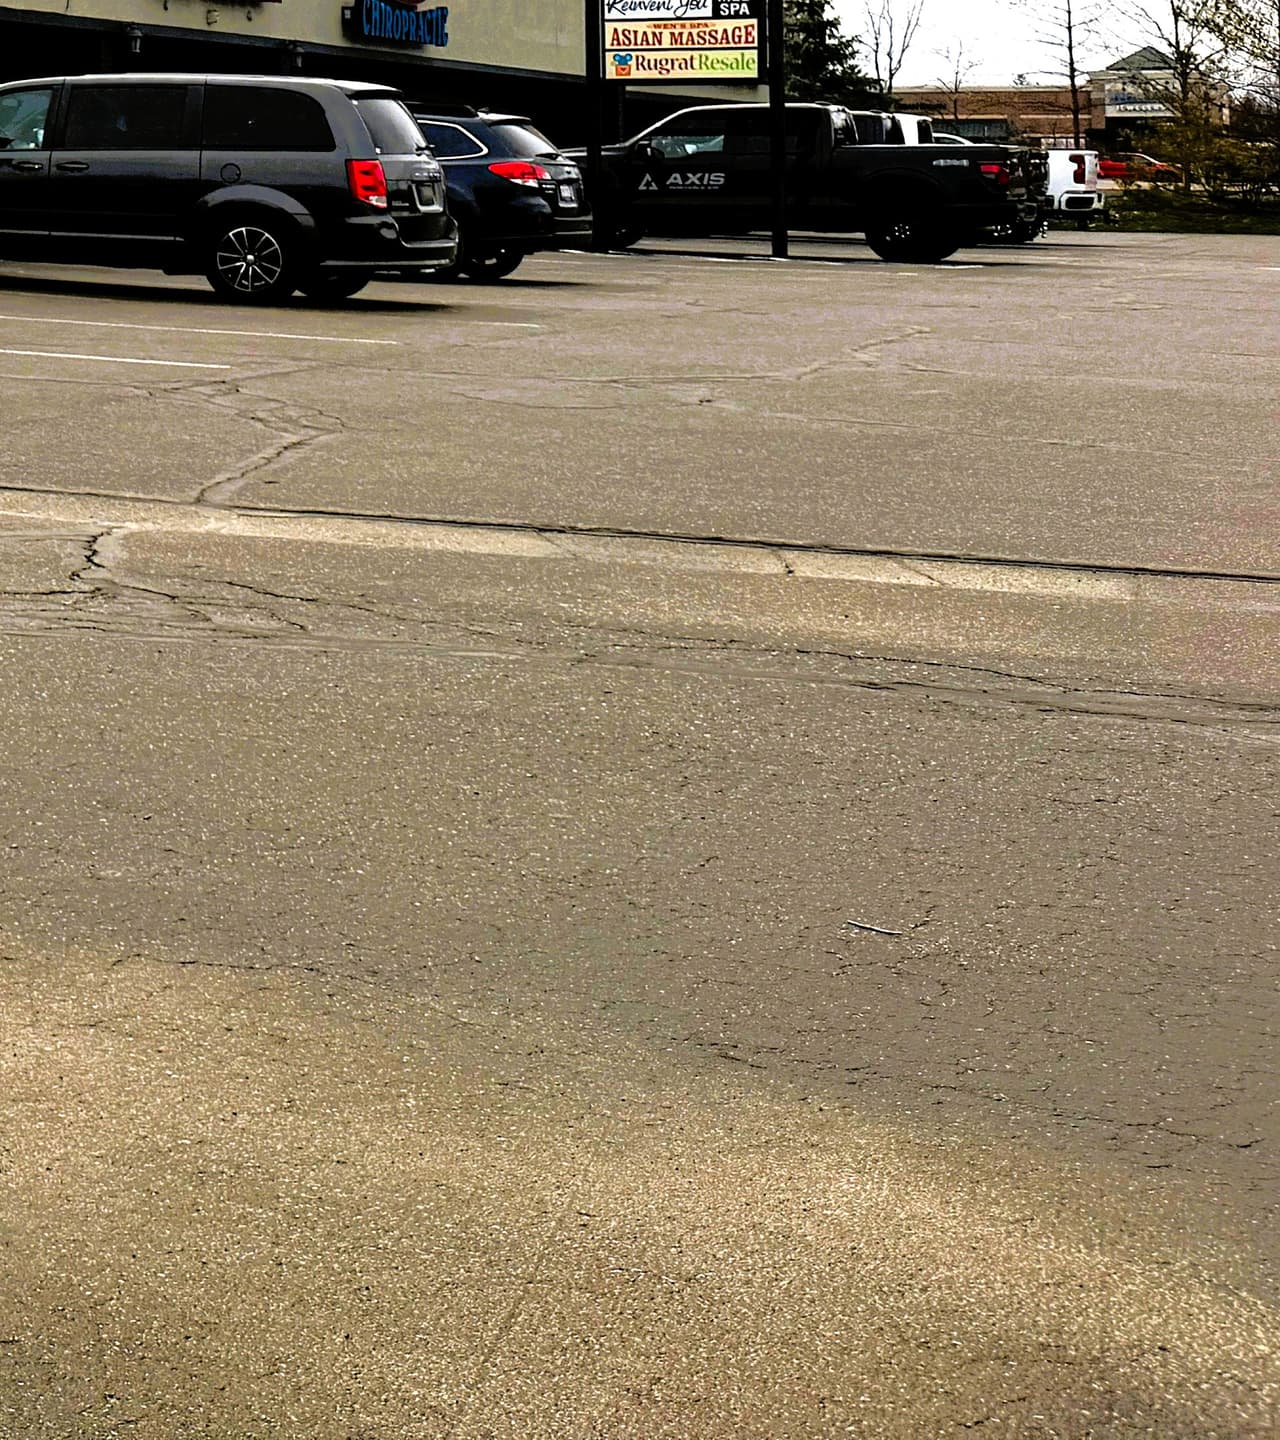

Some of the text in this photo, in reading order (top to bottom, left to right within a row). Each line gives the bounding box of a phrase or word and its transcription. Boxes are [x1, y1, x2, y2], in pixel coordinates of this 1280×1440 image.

[720, 3, 750, 16] SPA
[611, 24, 755, 47] ASIAN MASSAGE
[636, 52, 755, 75] Rugrat Resale
[666, 173, 726, 185] AXIS
